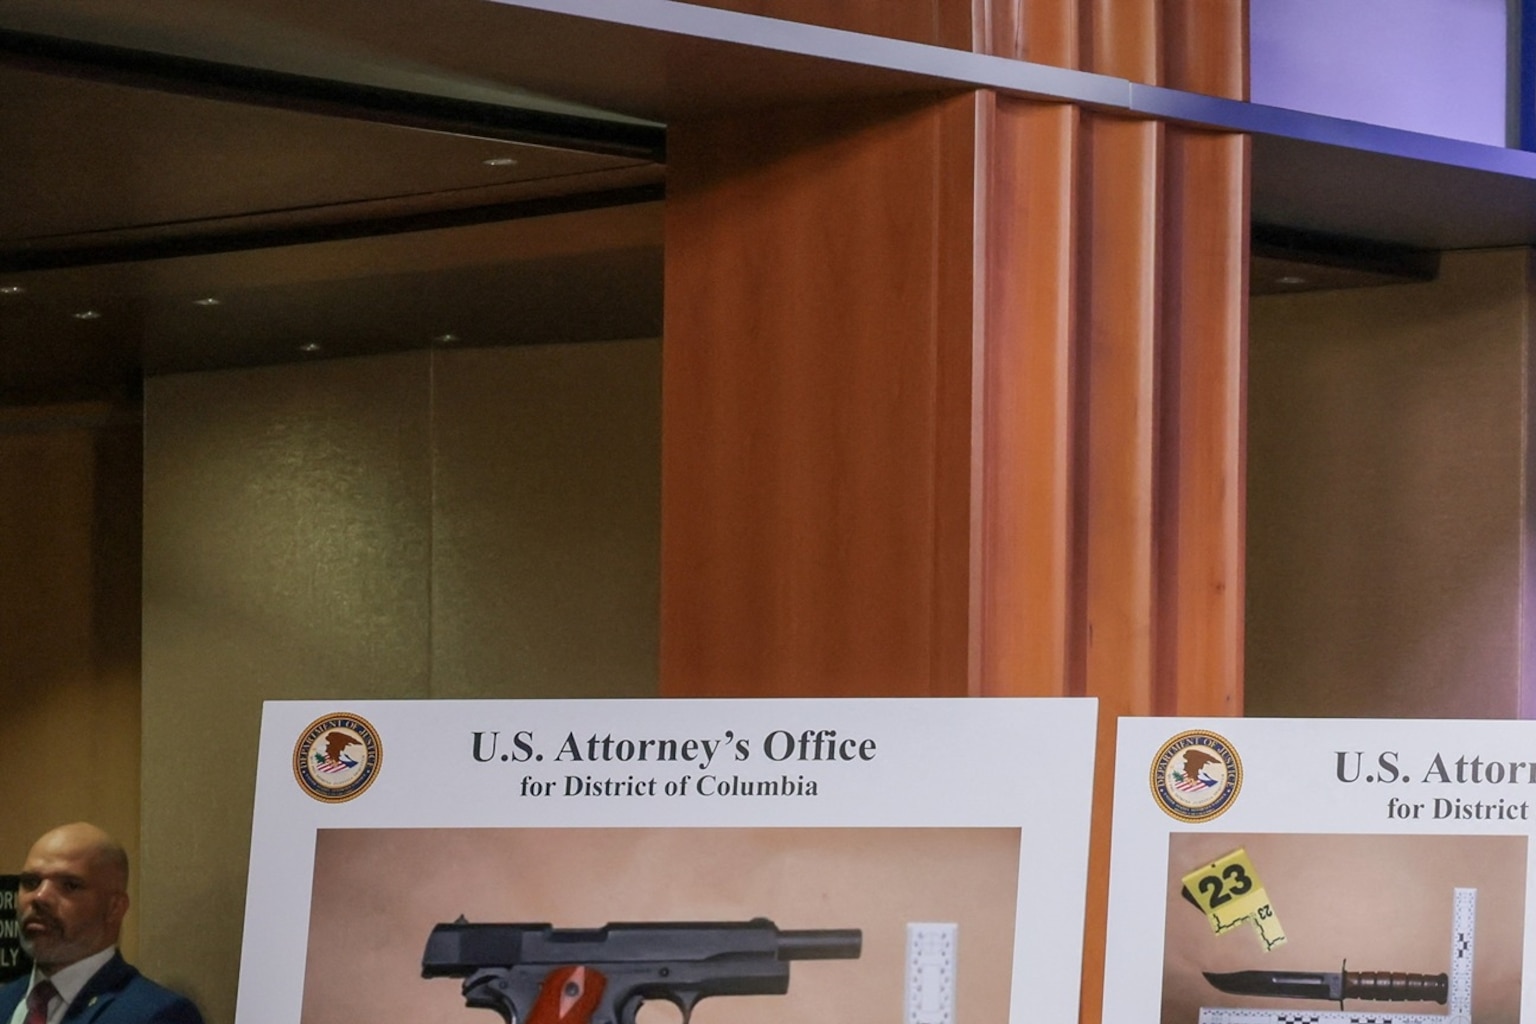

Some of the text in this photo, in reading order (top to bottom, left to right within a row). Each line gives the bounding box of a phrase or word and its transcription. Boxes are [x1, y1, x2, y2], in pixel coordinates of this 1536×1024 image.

[471, 729, 877, 769] U.S. Attorney’s Office
[1334, 751, 1410, 784] U.S.
[520, 775, 819, 797] for District of Columbia
[1387, 797, 1425, 820] for
[1432, 797, 1529, 820] District
[1198, 864, 1252, 909] 23
[1257, 904, 1273, 920] 23
